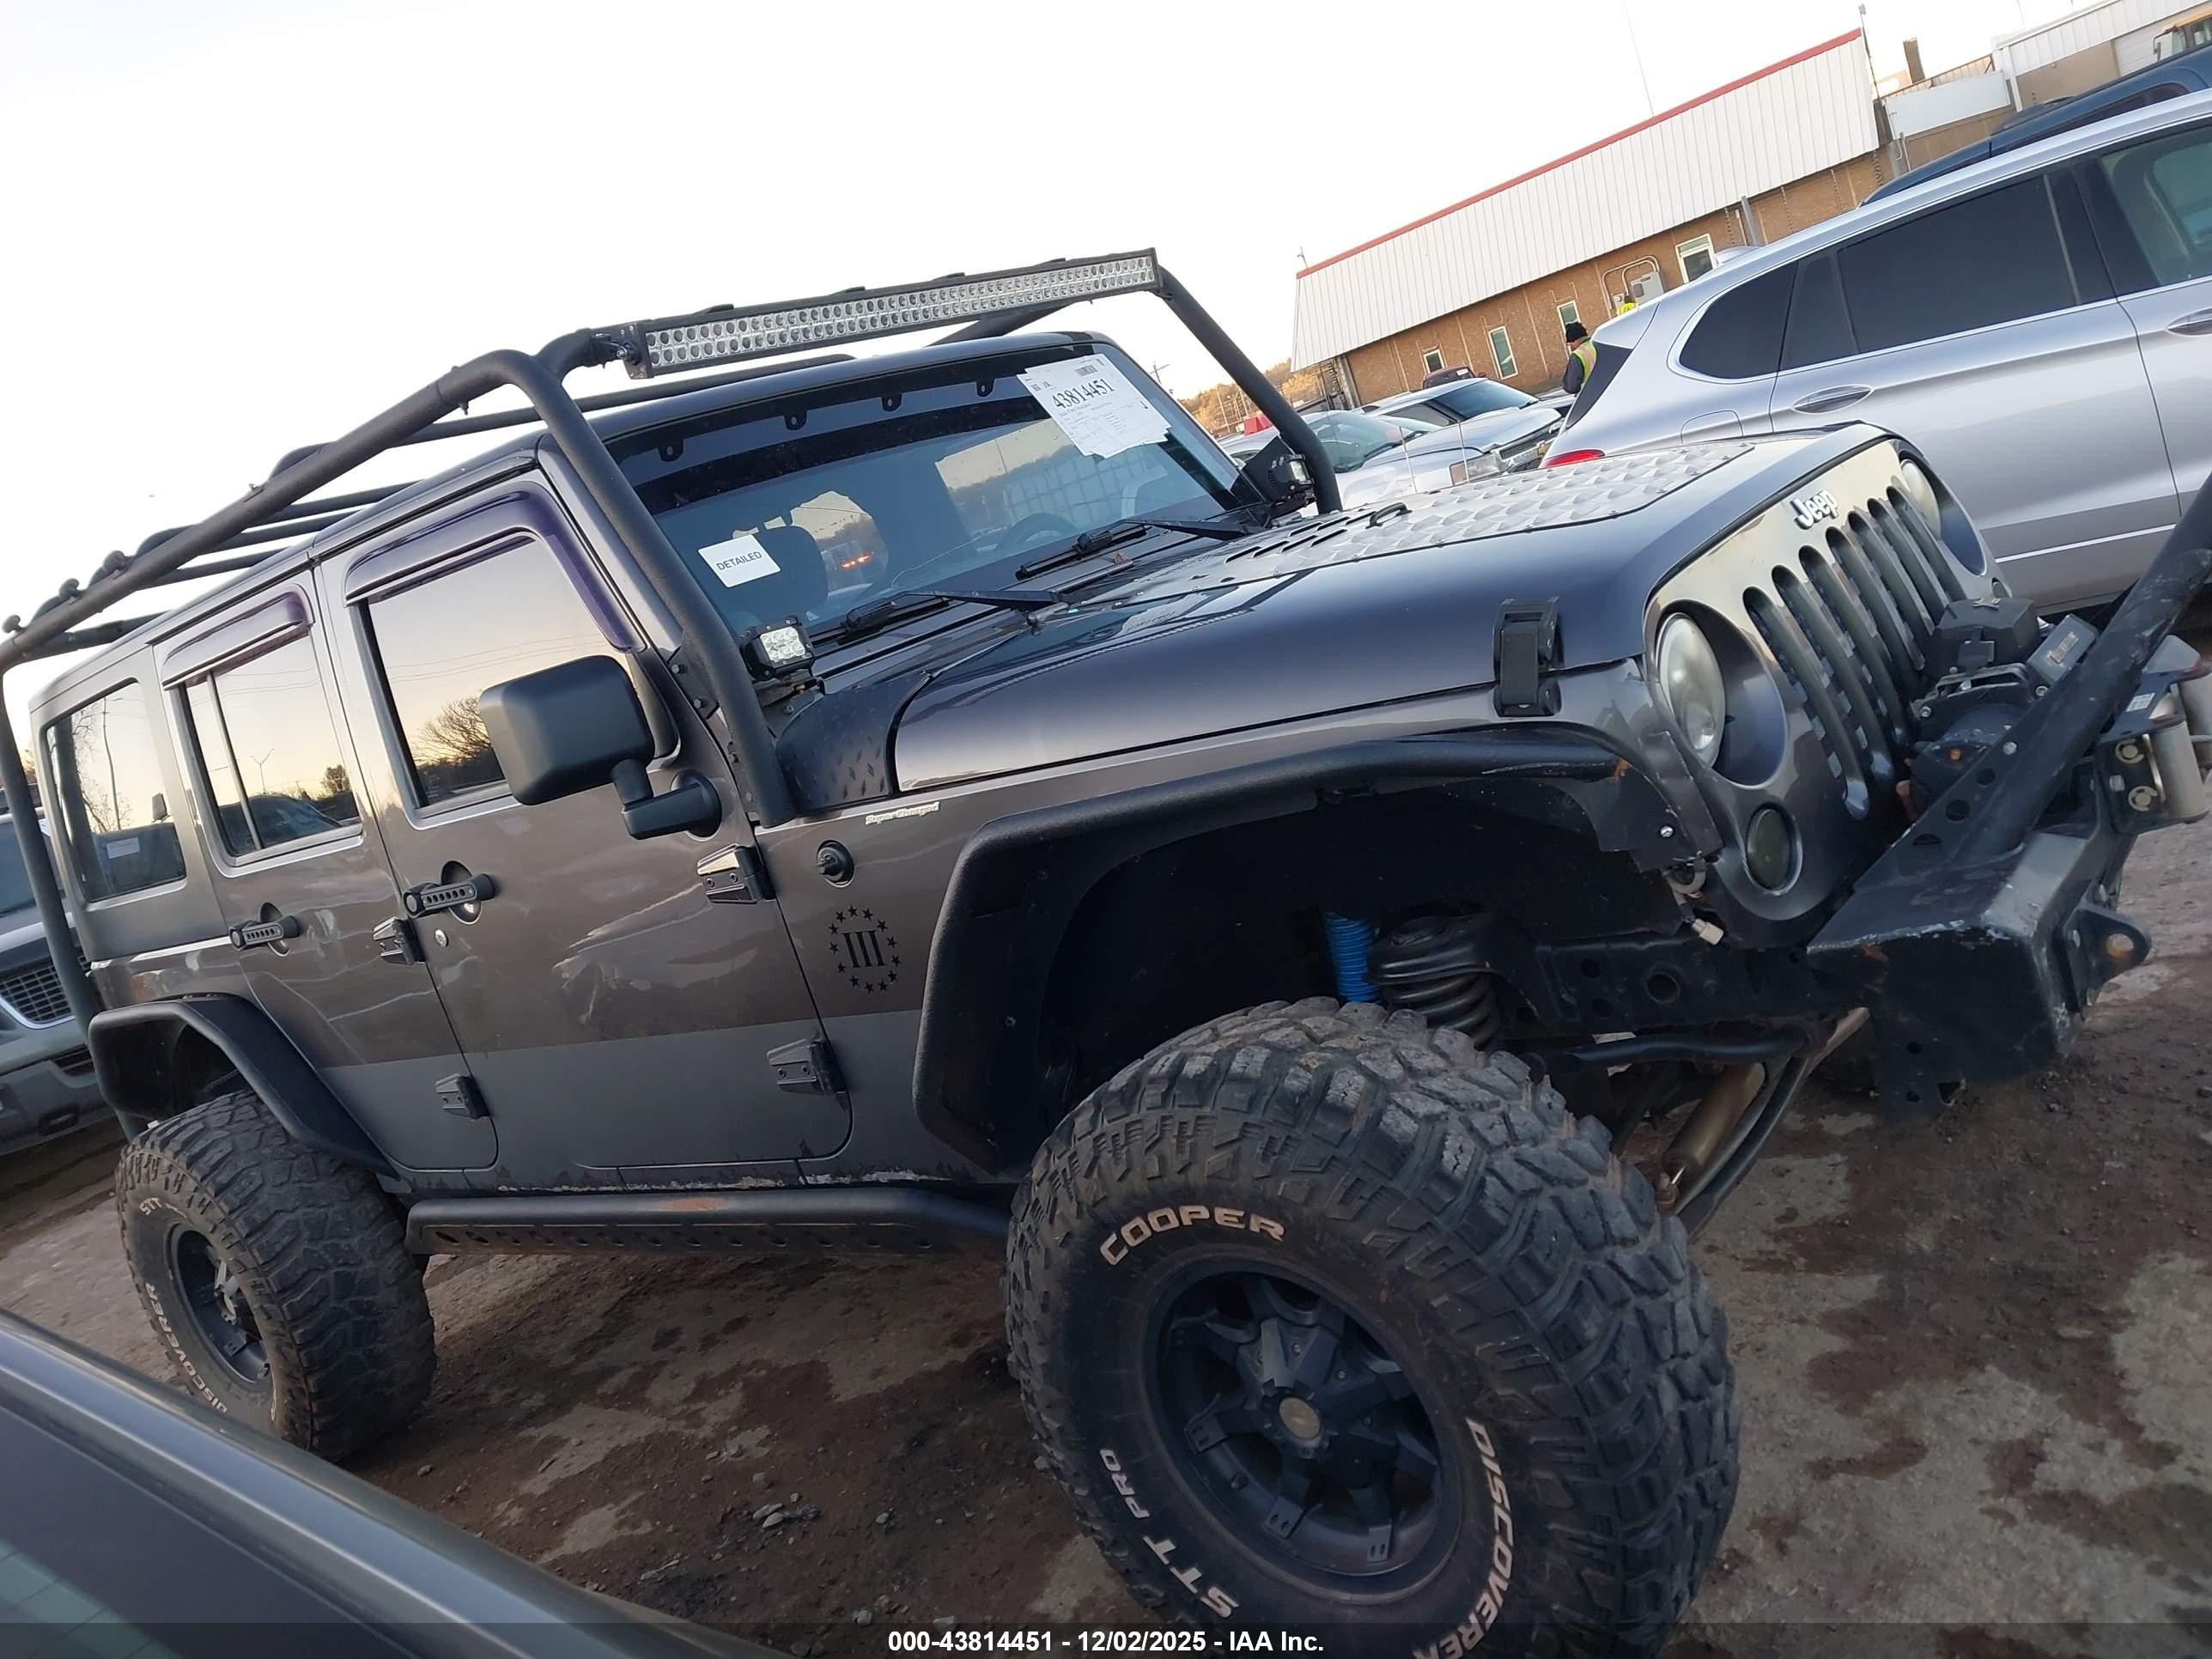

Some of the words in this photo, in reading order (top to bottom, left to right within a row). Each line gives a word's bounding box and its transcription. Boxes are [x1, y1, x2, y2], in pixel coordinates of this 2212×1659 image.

[1052, 378, 1115, 409] 43814451
[1789, 489, 1839, 530] Jeep
[716, 550, 763, 571] DETAILED
[1099, 1205, 1285, 1266] COOPER
[1100, 1449, 1151, 1519] PRO
[1143, 1536, 1239, 1619] STT
